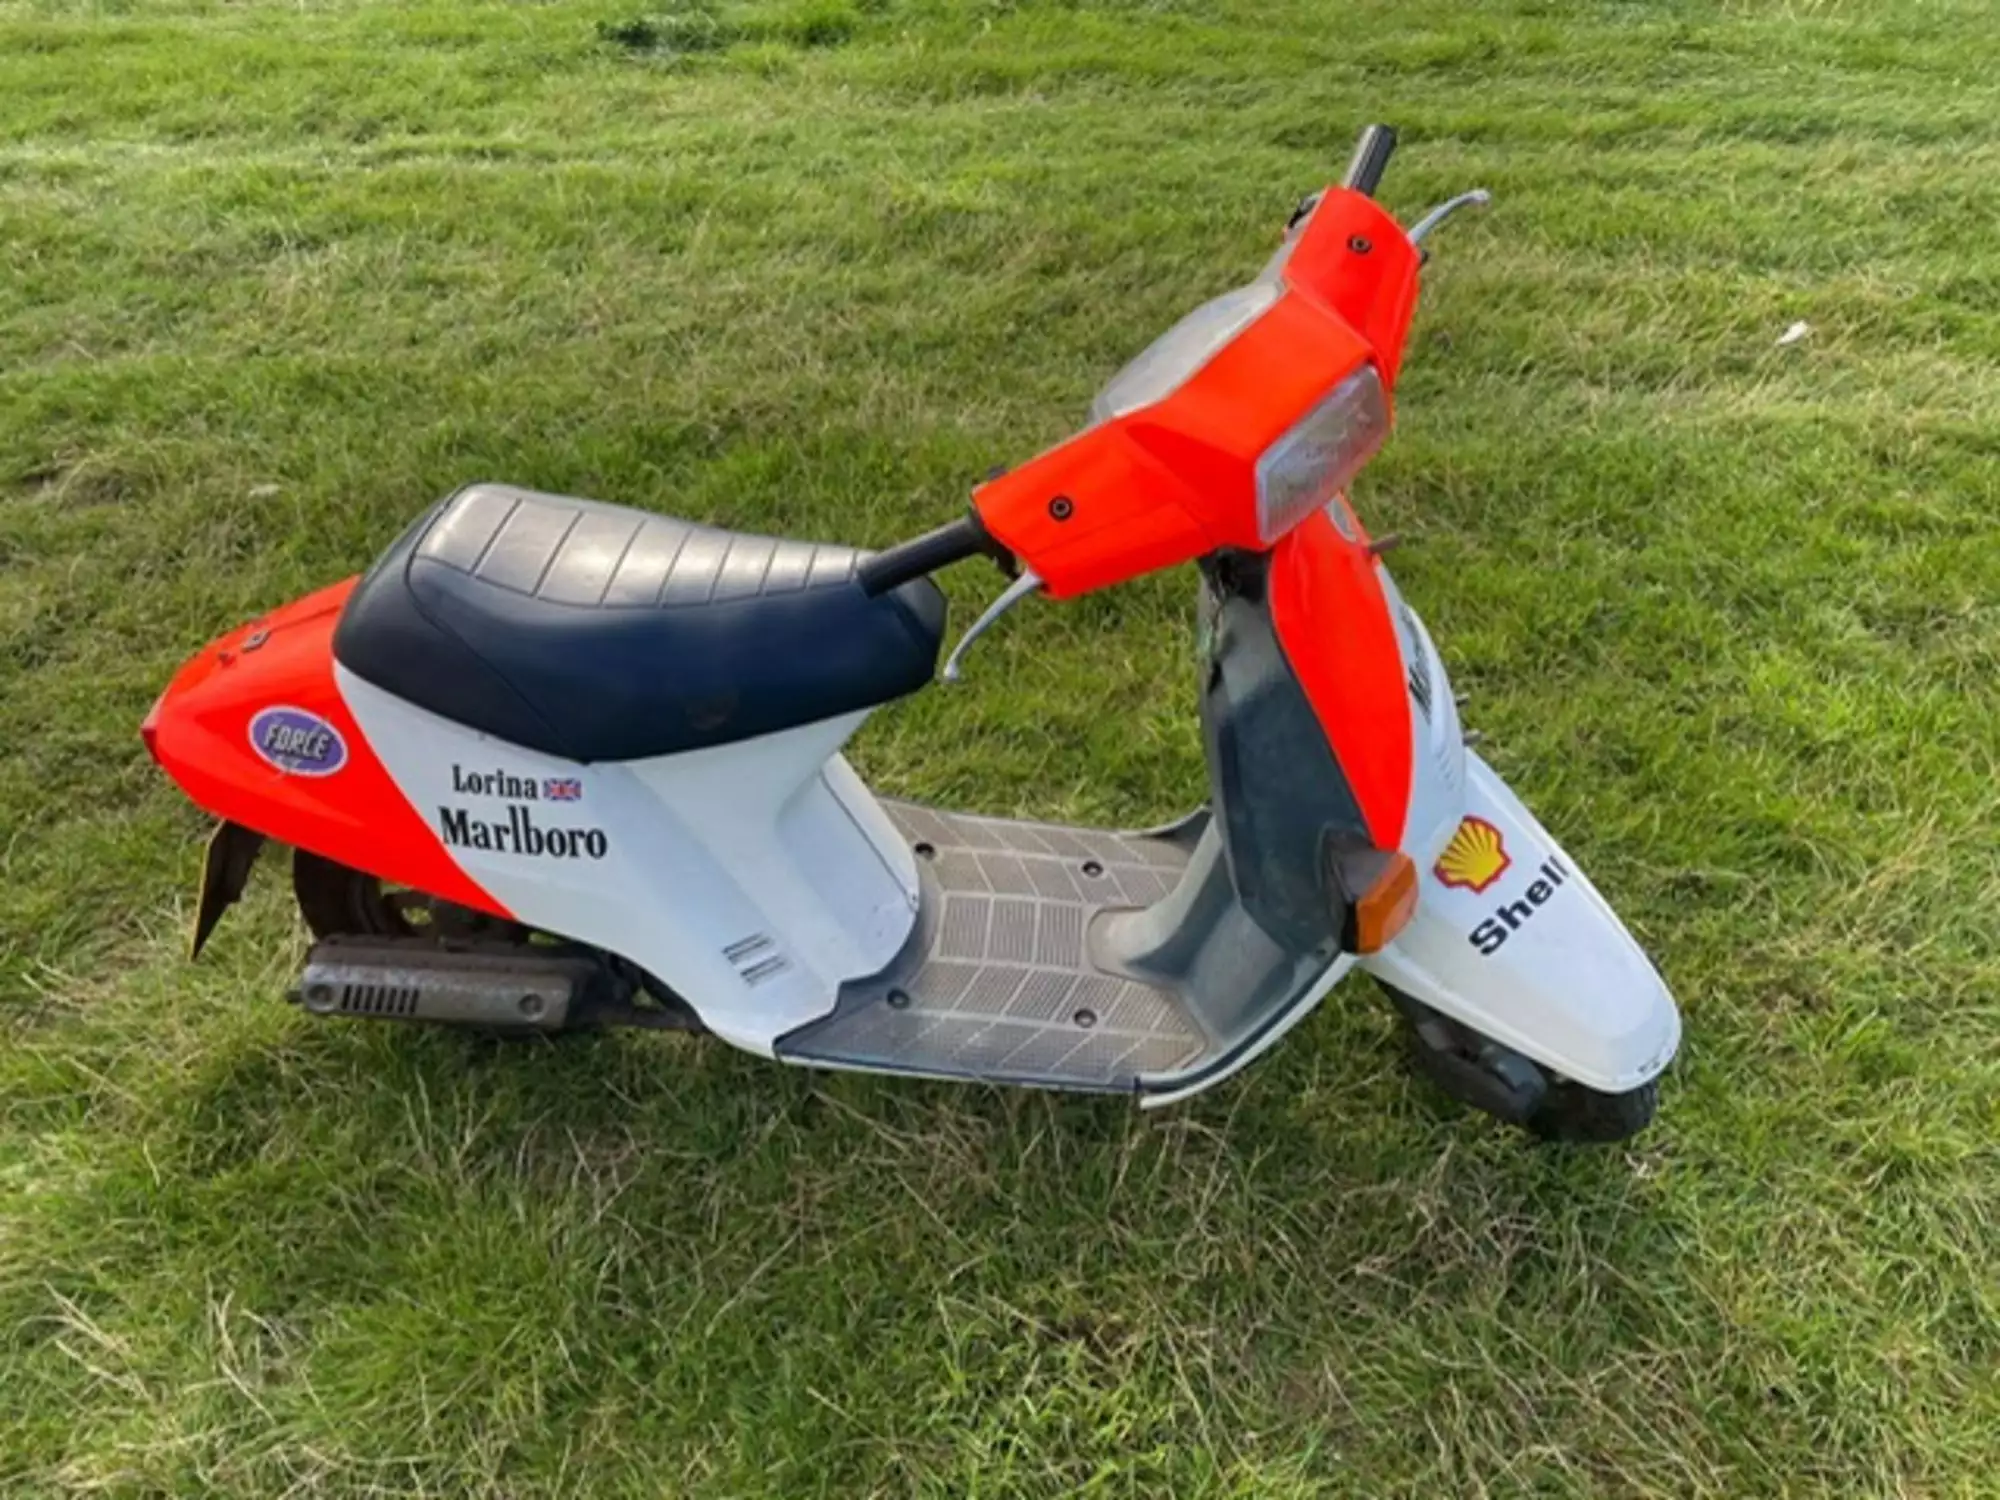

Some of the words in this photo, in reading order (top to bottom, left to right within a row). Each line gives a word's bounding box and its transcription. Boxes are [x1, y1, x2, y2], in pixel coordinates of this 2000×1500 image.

[263, 723, 330, 761] FORCE
[452, 763, 539, 800] Lorina
[438, 804, 608, 860] Marlboro
[1468, 854, 1570, 957] Shell
